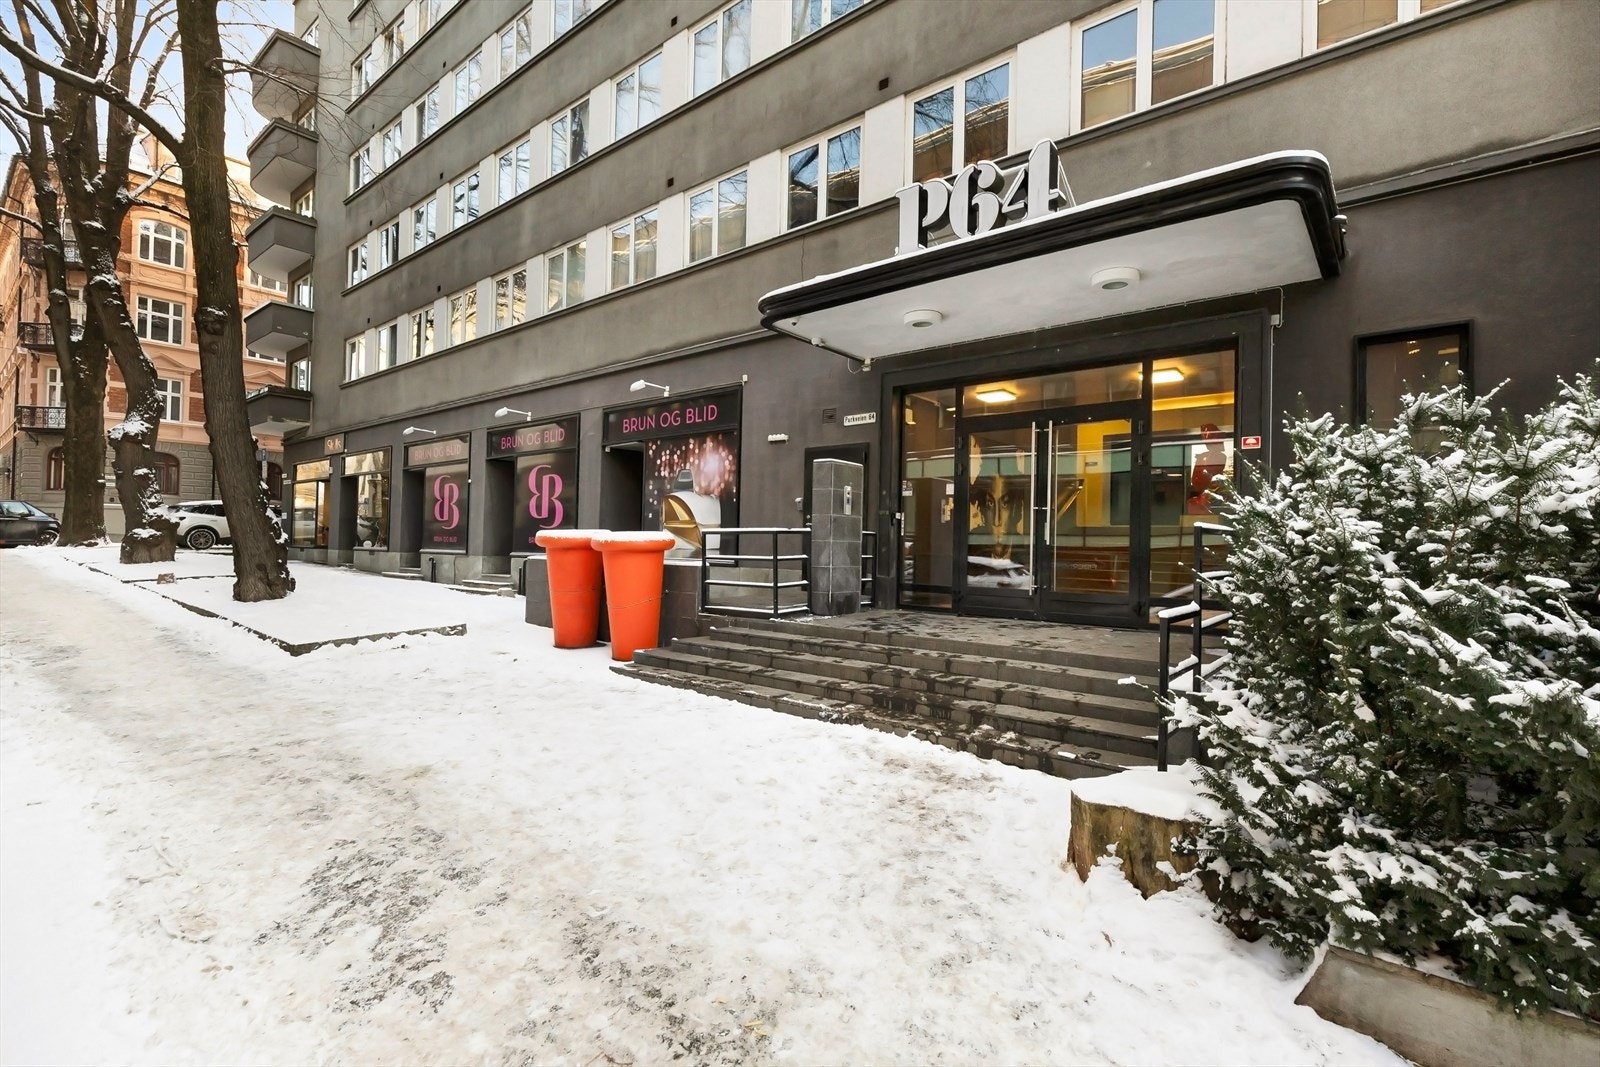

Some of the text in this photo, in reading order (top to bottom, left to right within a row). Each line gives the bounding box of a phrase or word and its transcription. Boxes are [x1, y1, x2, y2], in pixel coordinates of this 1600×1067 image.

[895, 138, 1065, 256] P64
[623, 404, 718, 433] BRUN OG BLID
[501, 428, 566, 450] BRUN OG BLID
[415, 444, 461, 460] BRUN OG BLID
